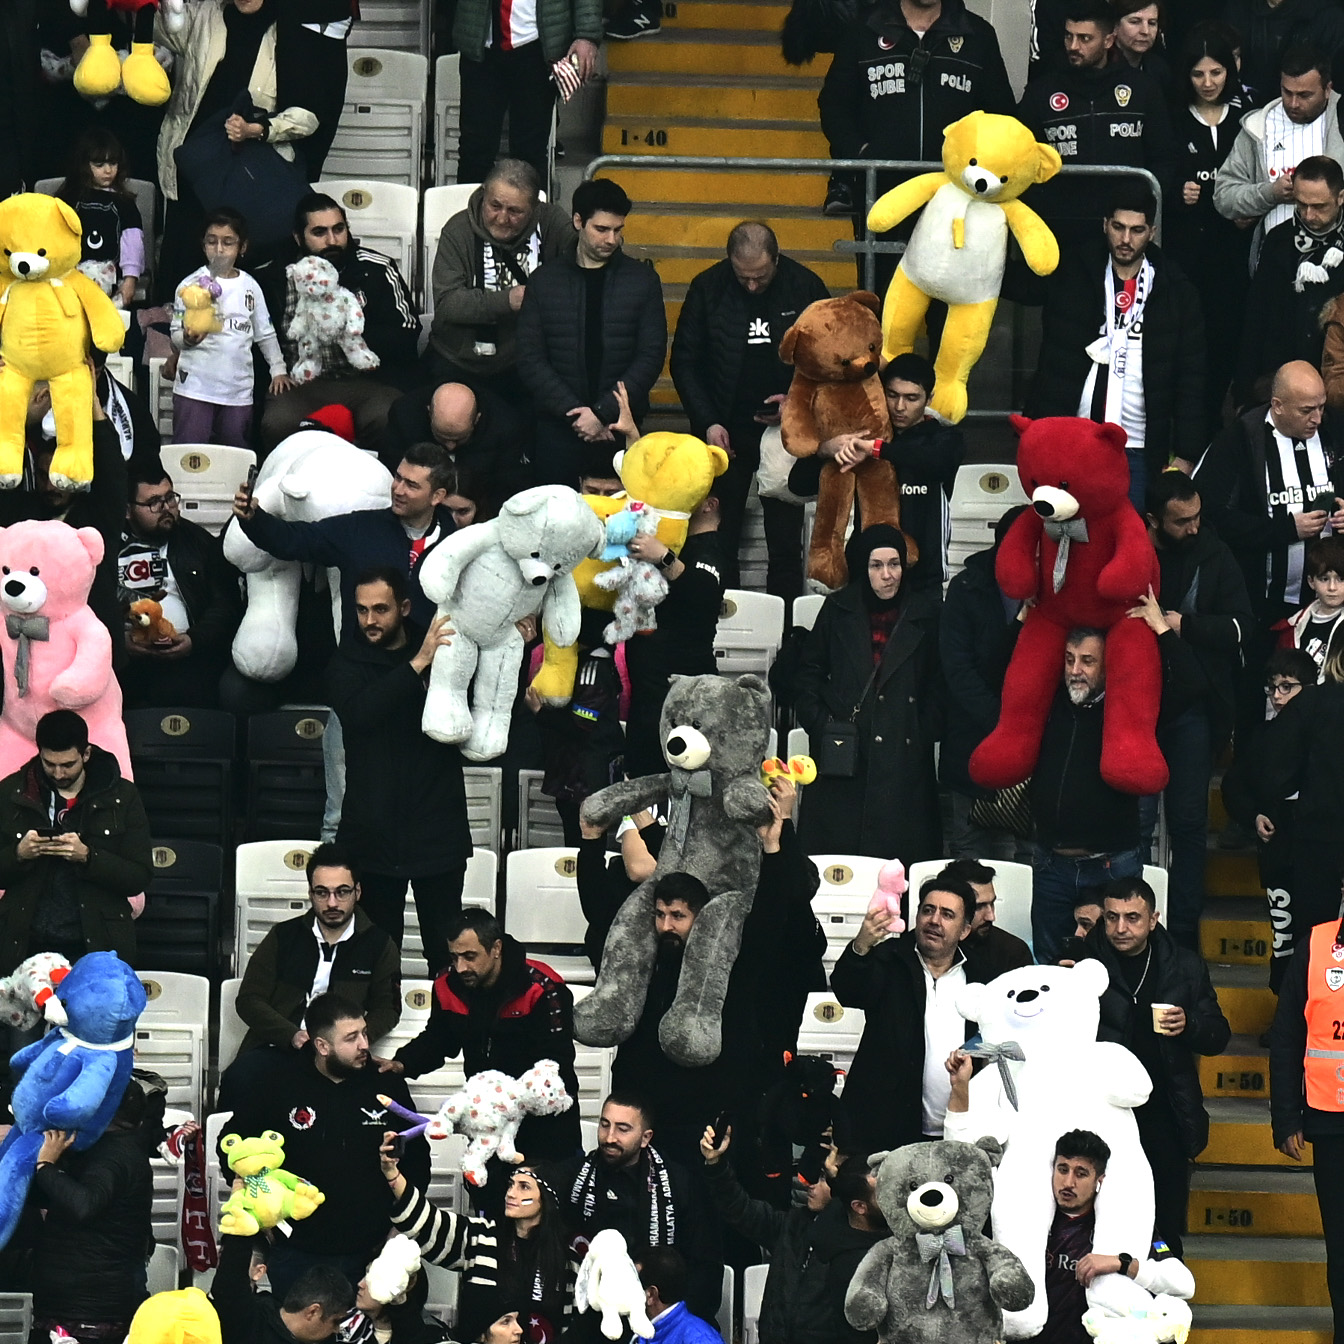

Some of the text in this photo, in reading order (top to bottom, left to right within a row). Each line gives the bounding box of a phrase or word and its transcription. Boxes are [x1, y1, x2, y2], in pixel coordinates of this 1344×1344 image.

[868, 62, 904, 81] SPOR
[869, 80, 904, 99] ŞUBE
[938, 72, 972, 94] POLİS
[1060, 141, 1078, 157] UBE
[1269, 487, 1304, 506] cola
[658, 1168, 672, 1198] ADANA
